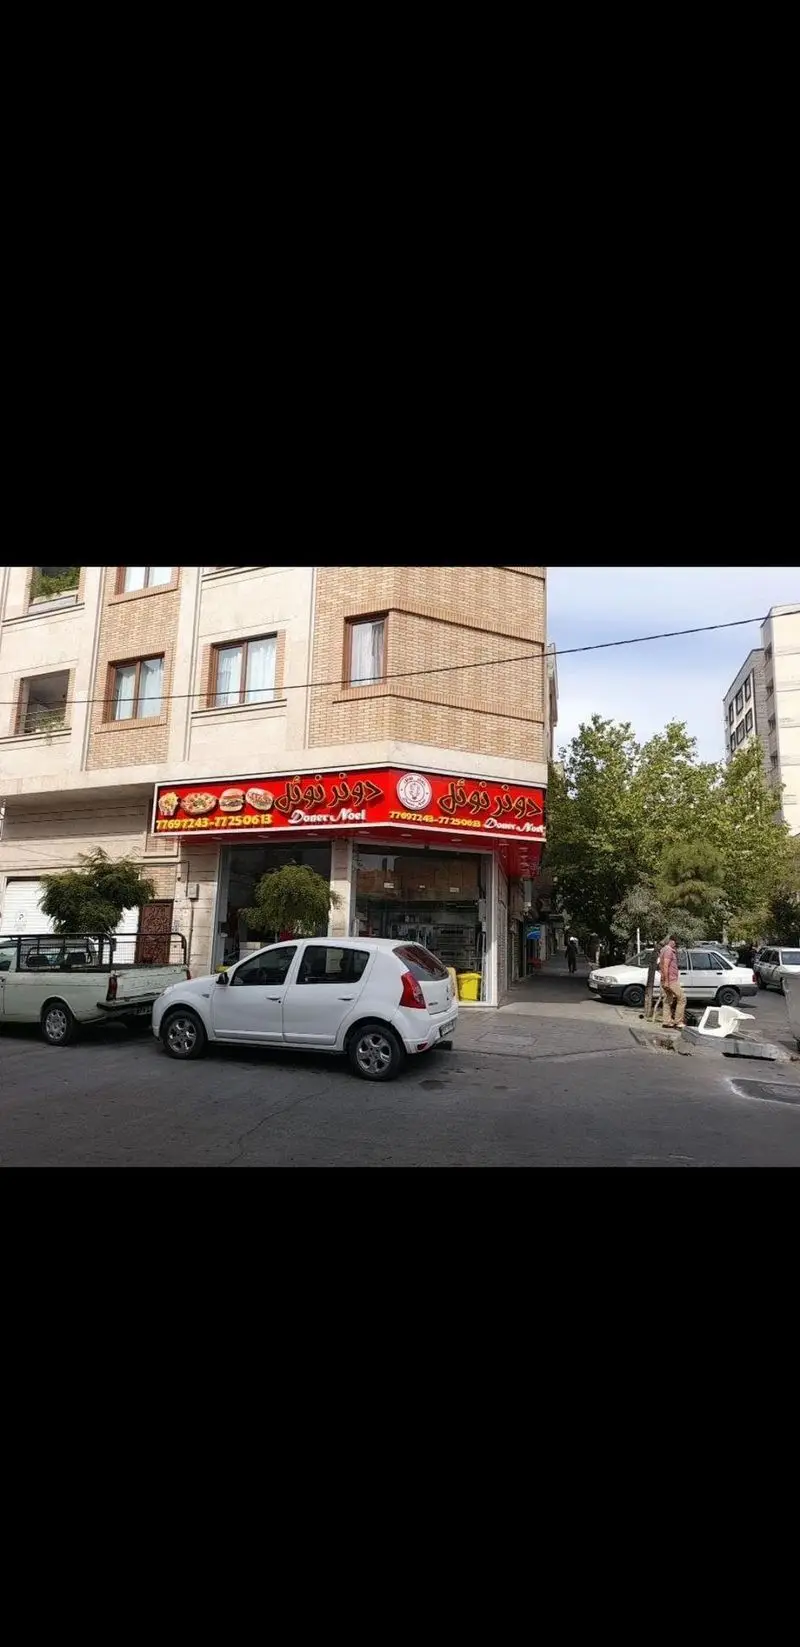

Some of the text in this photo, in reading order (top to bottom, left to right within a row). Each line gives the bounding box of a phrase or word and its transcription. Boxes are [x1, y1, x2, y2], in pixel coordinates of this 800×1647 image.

[274, 773, 384, 814] دونر نوئل
[437, 778, 543, 819] دونر نوئل
[288, 808, 366, 824] Doner Noel
